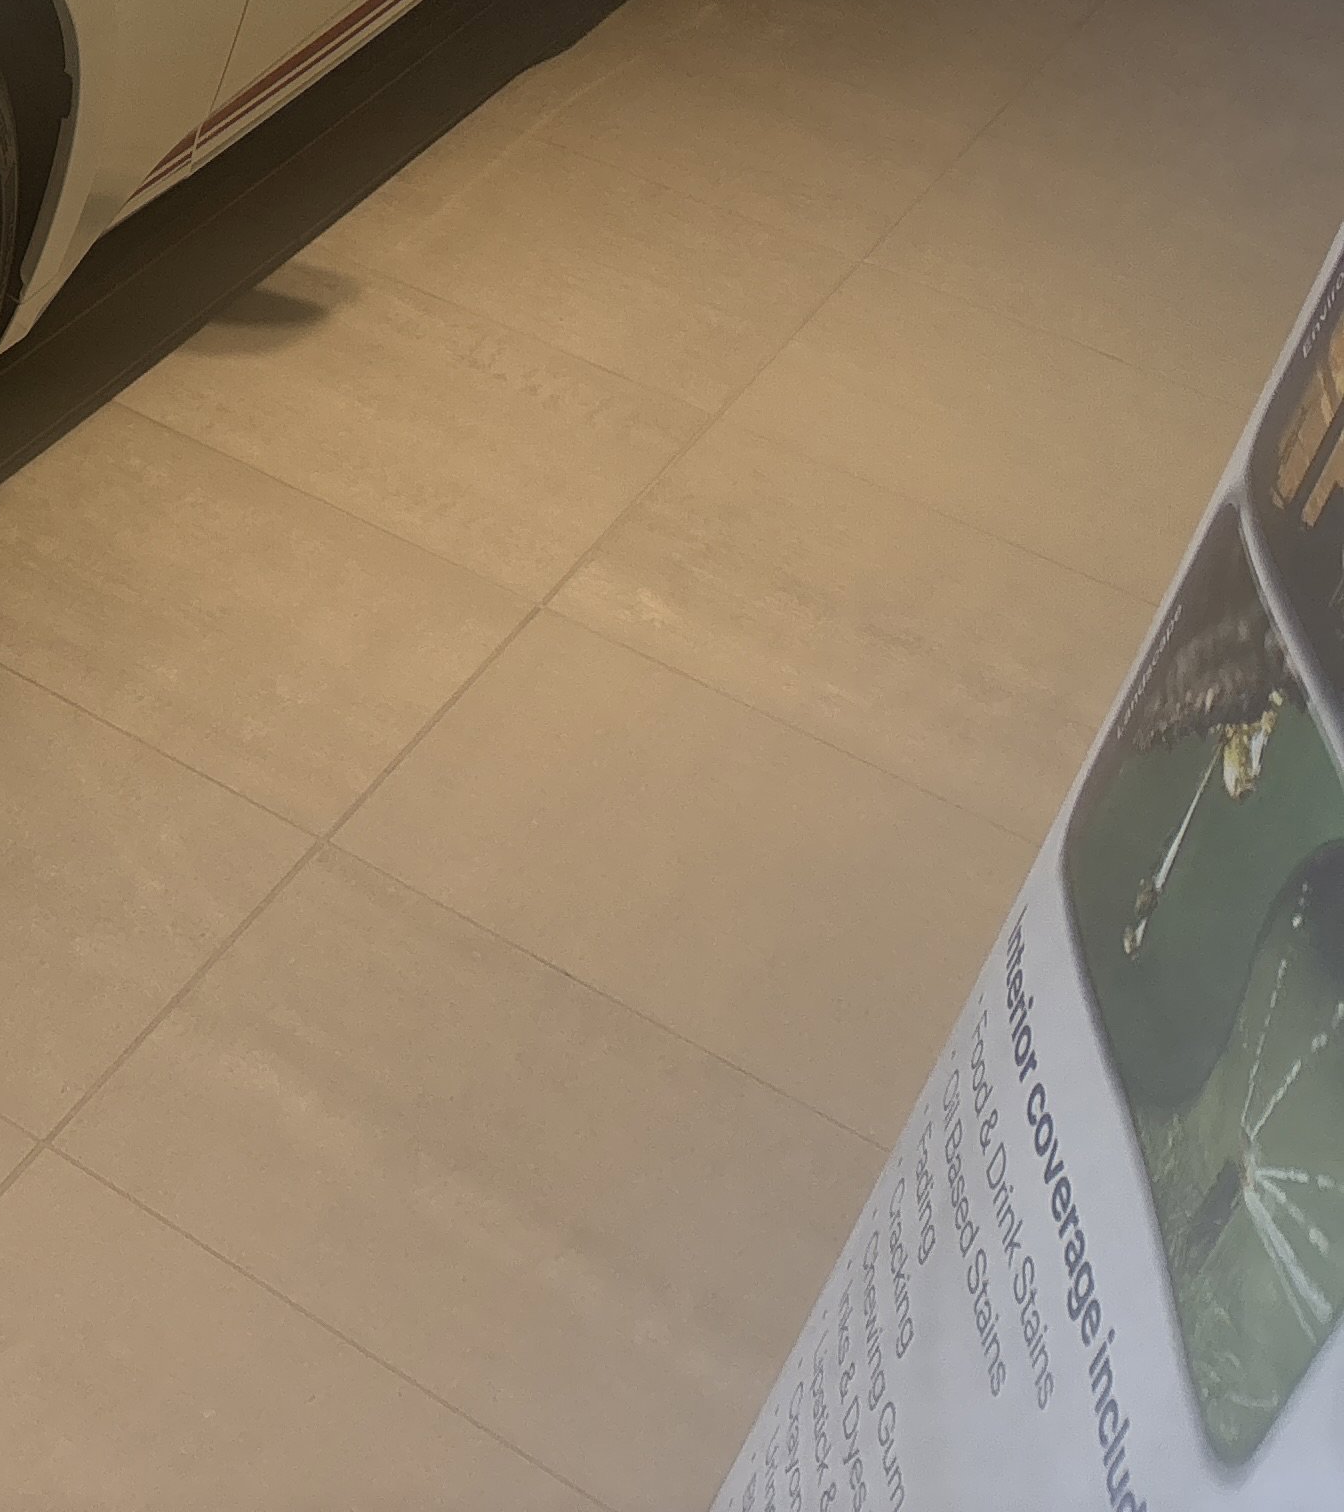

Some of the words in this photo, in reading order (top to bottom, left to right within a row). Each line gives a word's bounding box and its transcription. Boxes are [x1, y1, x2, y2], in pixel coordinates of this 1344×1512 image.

[915, 1120, 936, 1266] Fading
[1006, 903, 1038, 1083] Interior
[1026, 1082, 1101, 1346] coverage
[889, 1177, 914, 1359] Cracking
[971, 1009, 994, 1119] Food
[986, 1142, 1024, 1269] Drink
[1013, 1255, 1054, 1410] Stains
[967, 1248, 1007, 1397] Stains
[877, 1400, 905, 1512] Gum
